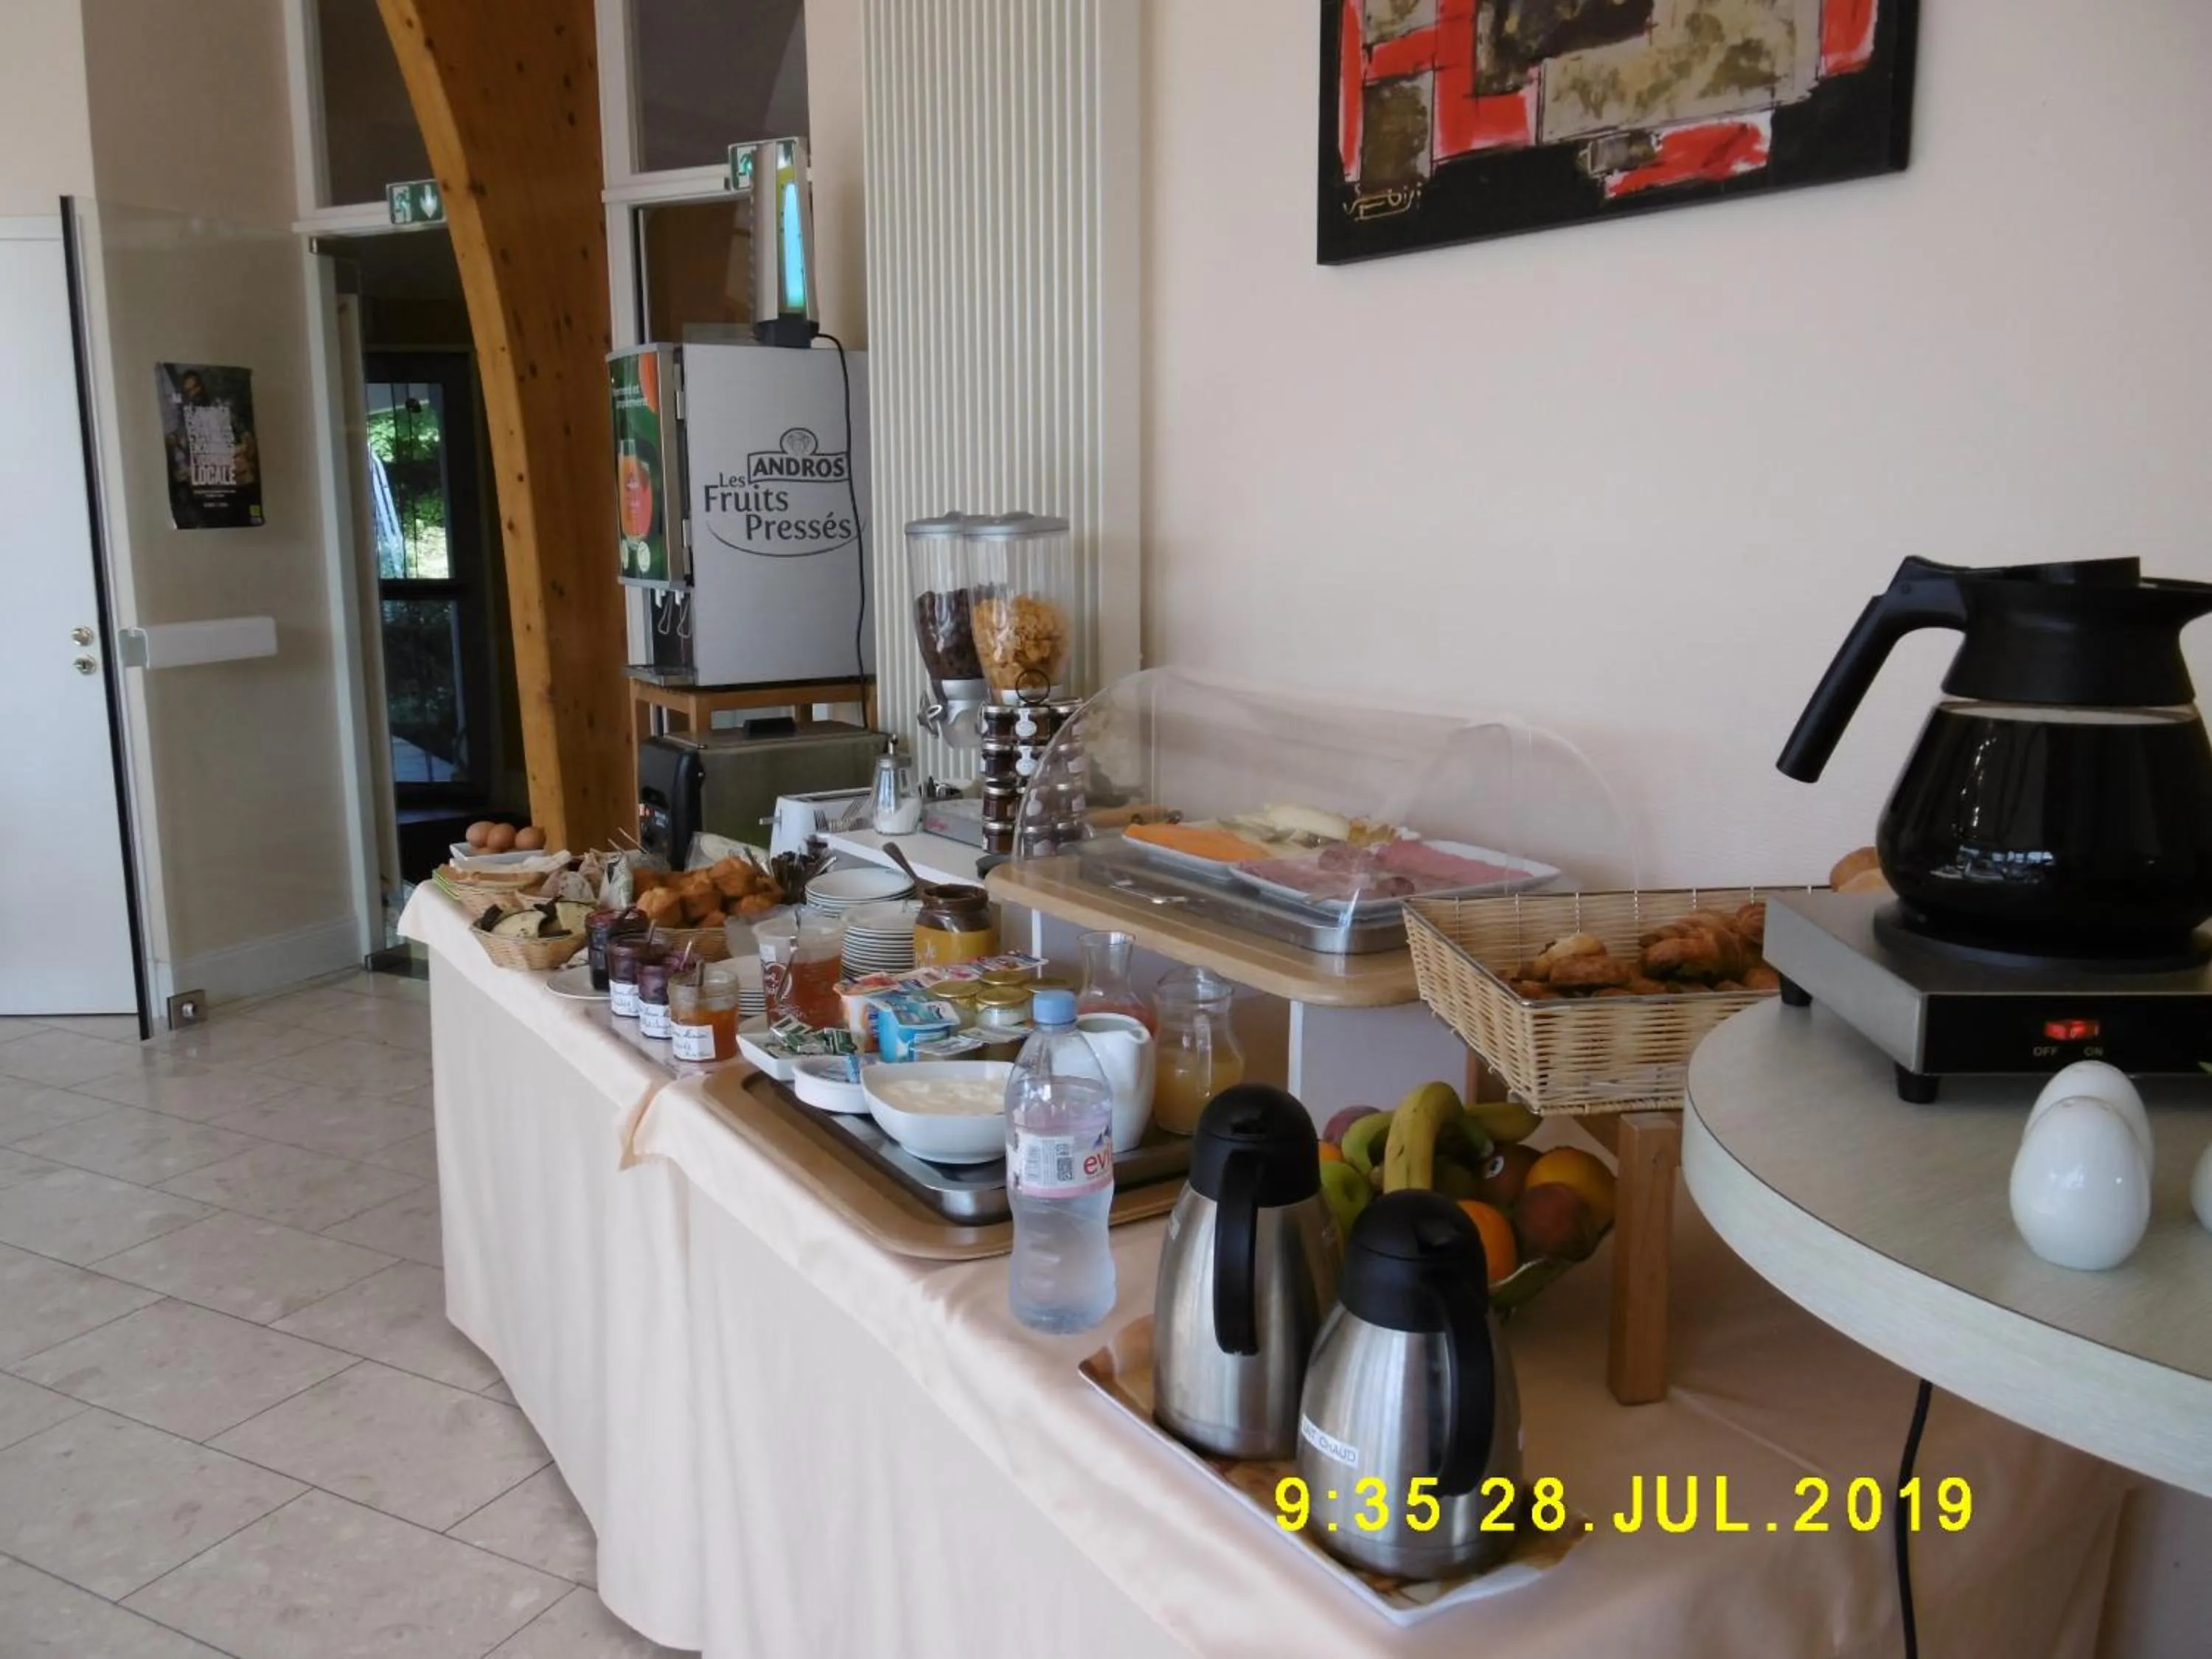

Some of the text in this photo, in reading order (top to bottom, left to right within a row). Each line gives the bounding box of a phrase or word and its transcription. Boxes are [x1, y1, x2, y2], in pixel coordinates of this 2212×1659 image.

[191, 465, 236, 486] LOCALE
[753, 457, 845, 477] ANDROS
[719, 472, 745, 488] Les
[703, 484, 789, 512] Fruits
[745, 511, 852, 540] Pressés
[2033, 1046, 2104, 1057] OFF ON
